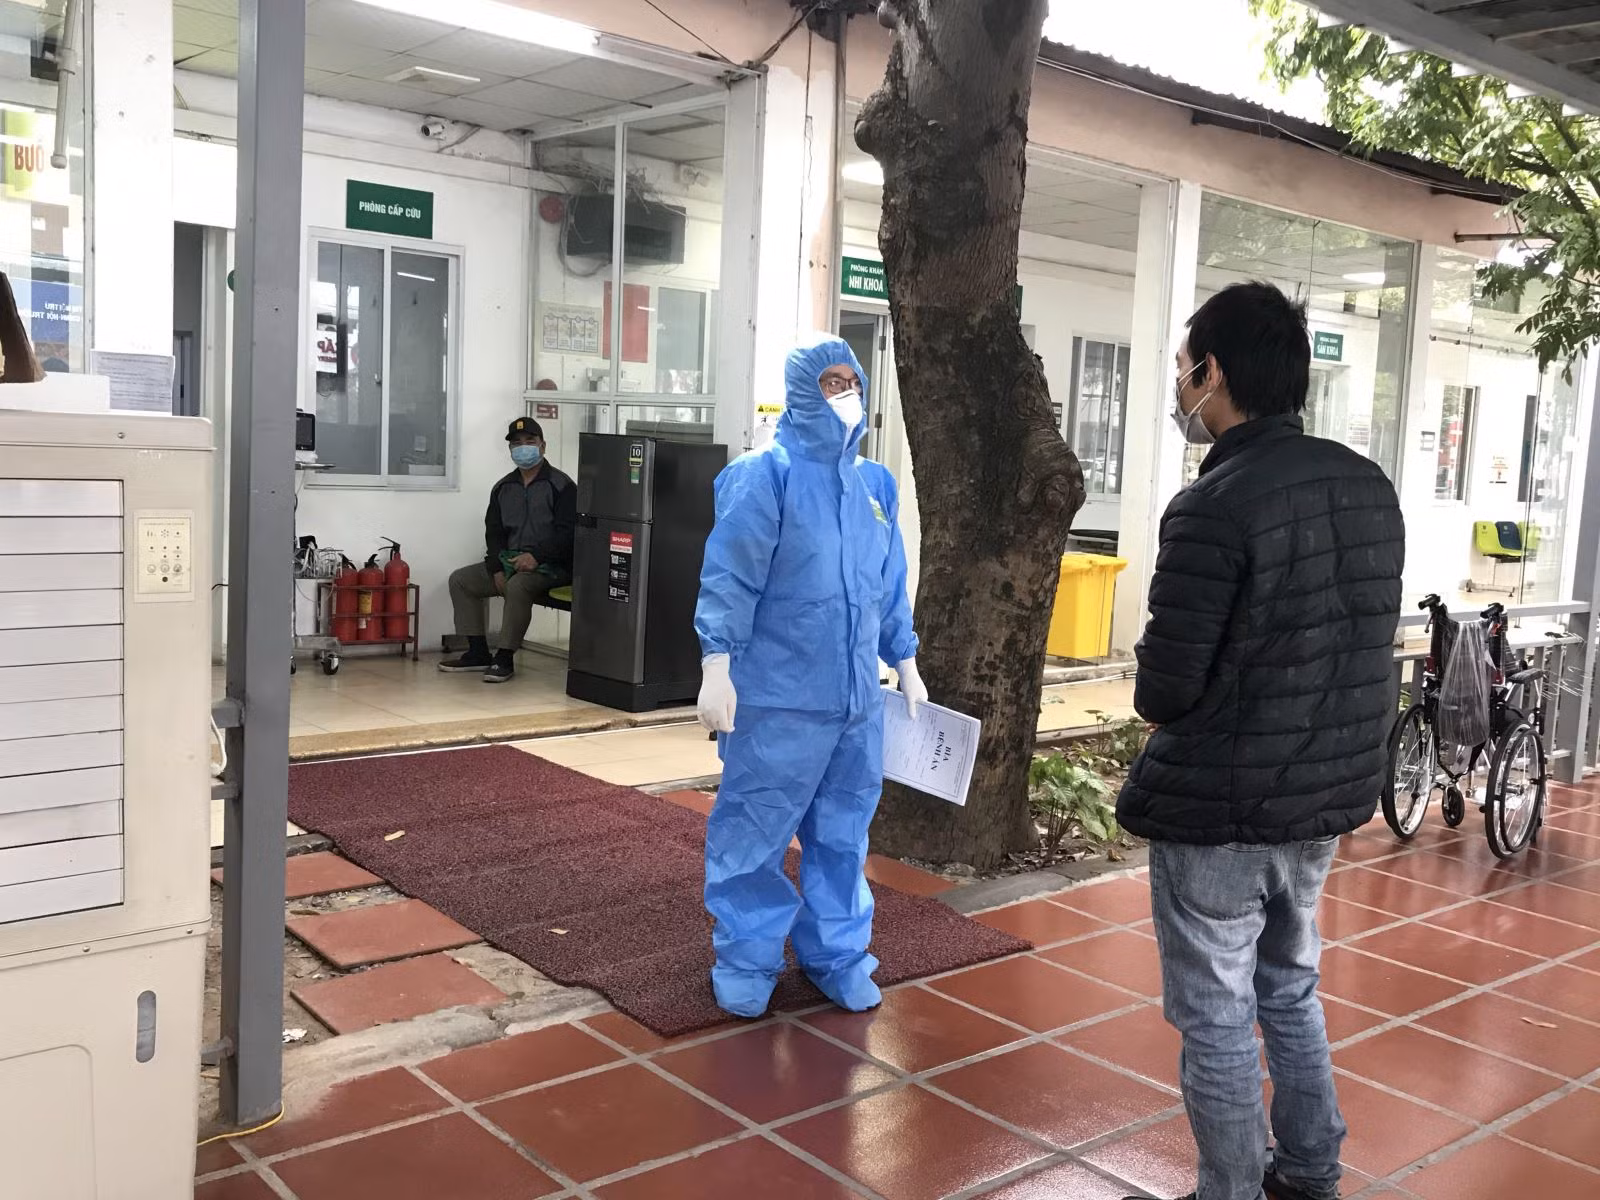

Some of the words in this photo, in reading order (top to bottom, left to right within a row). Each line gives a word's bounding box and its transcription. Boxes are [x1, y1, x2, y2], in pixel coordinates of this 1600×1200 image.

[359, 200, 386, 214] PHÒNG
[388, 203, 404, 216] CẤP
[405, 207, 422, 219] CỨU
[851, 264, 869, 273] PHÒNG
[848, 275, 863, 289] NHI
[863, 277, 884, 293] KHOA
[632, 448, 641, 456] 10
